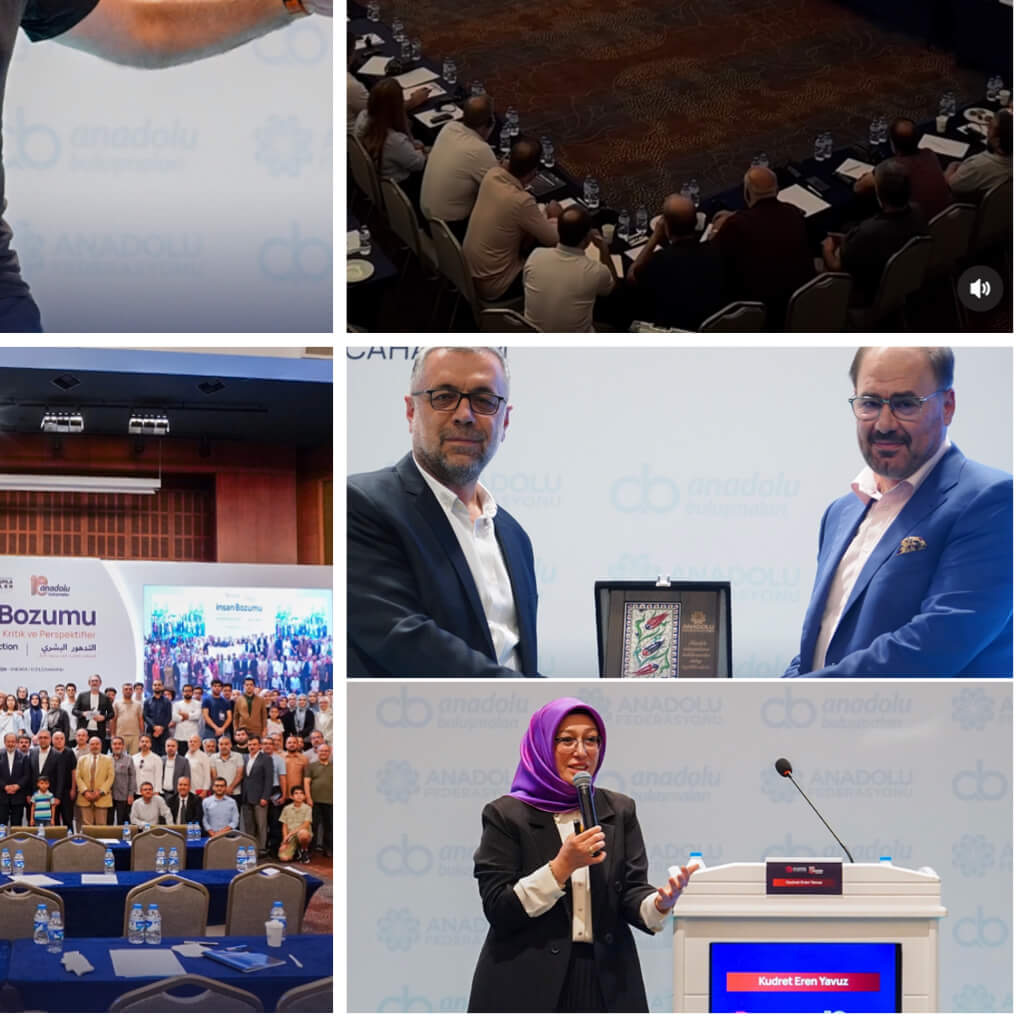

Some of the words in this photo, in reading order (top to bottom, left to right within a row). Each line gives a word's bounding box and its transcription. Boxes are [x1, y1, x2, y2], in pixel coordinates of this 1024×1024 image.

[39, 583, 70, 592] anadolu
[2, 629, 24, 638] Kritik
[40, 629, 96, 641] Perspektifler
[617, 696, 723, 713] ANADOLU
[821, 689, 913, 714] anadolu
[631, 766, 721, 786] anadolu
[810, 768, 913, 786] ANADOLU
[758, 976, 793, 987] Kudret
[794, 976, 818, 987] Eren
[819, 976, 849, 987] Yavuz
